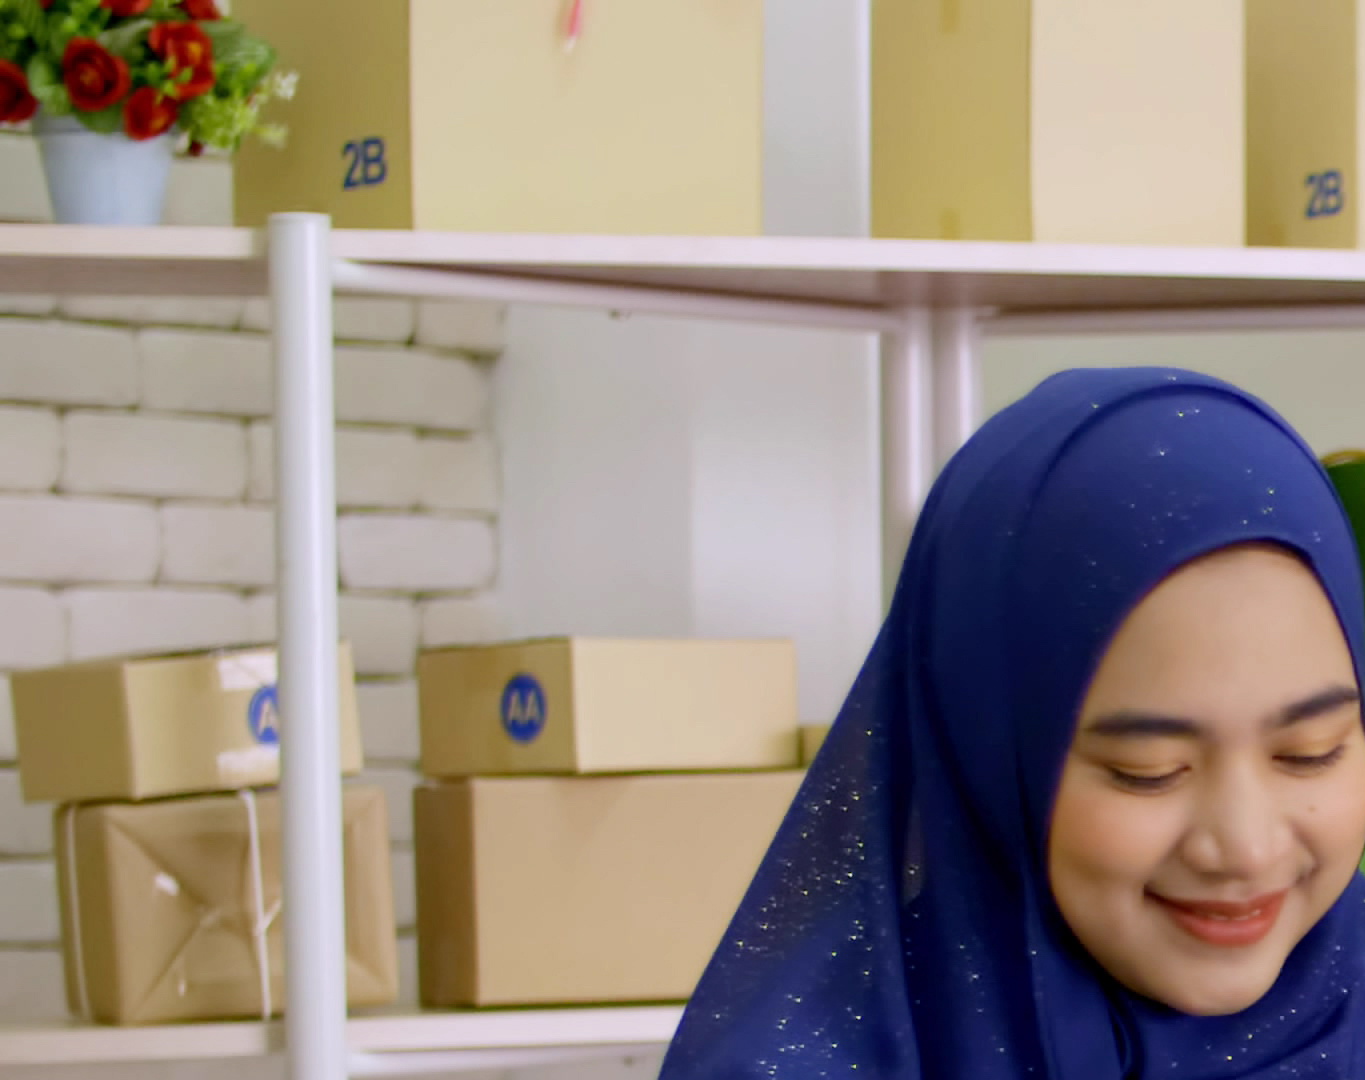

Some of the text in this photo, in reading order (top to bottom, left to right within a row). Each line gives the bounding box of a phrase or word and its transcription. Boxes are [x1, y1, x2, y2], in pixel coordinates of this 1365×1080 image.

[342, 137, 387, 190] 2B
[1305, 170, 1345, 218] 2B
[506, 688, 541, 726] AA
